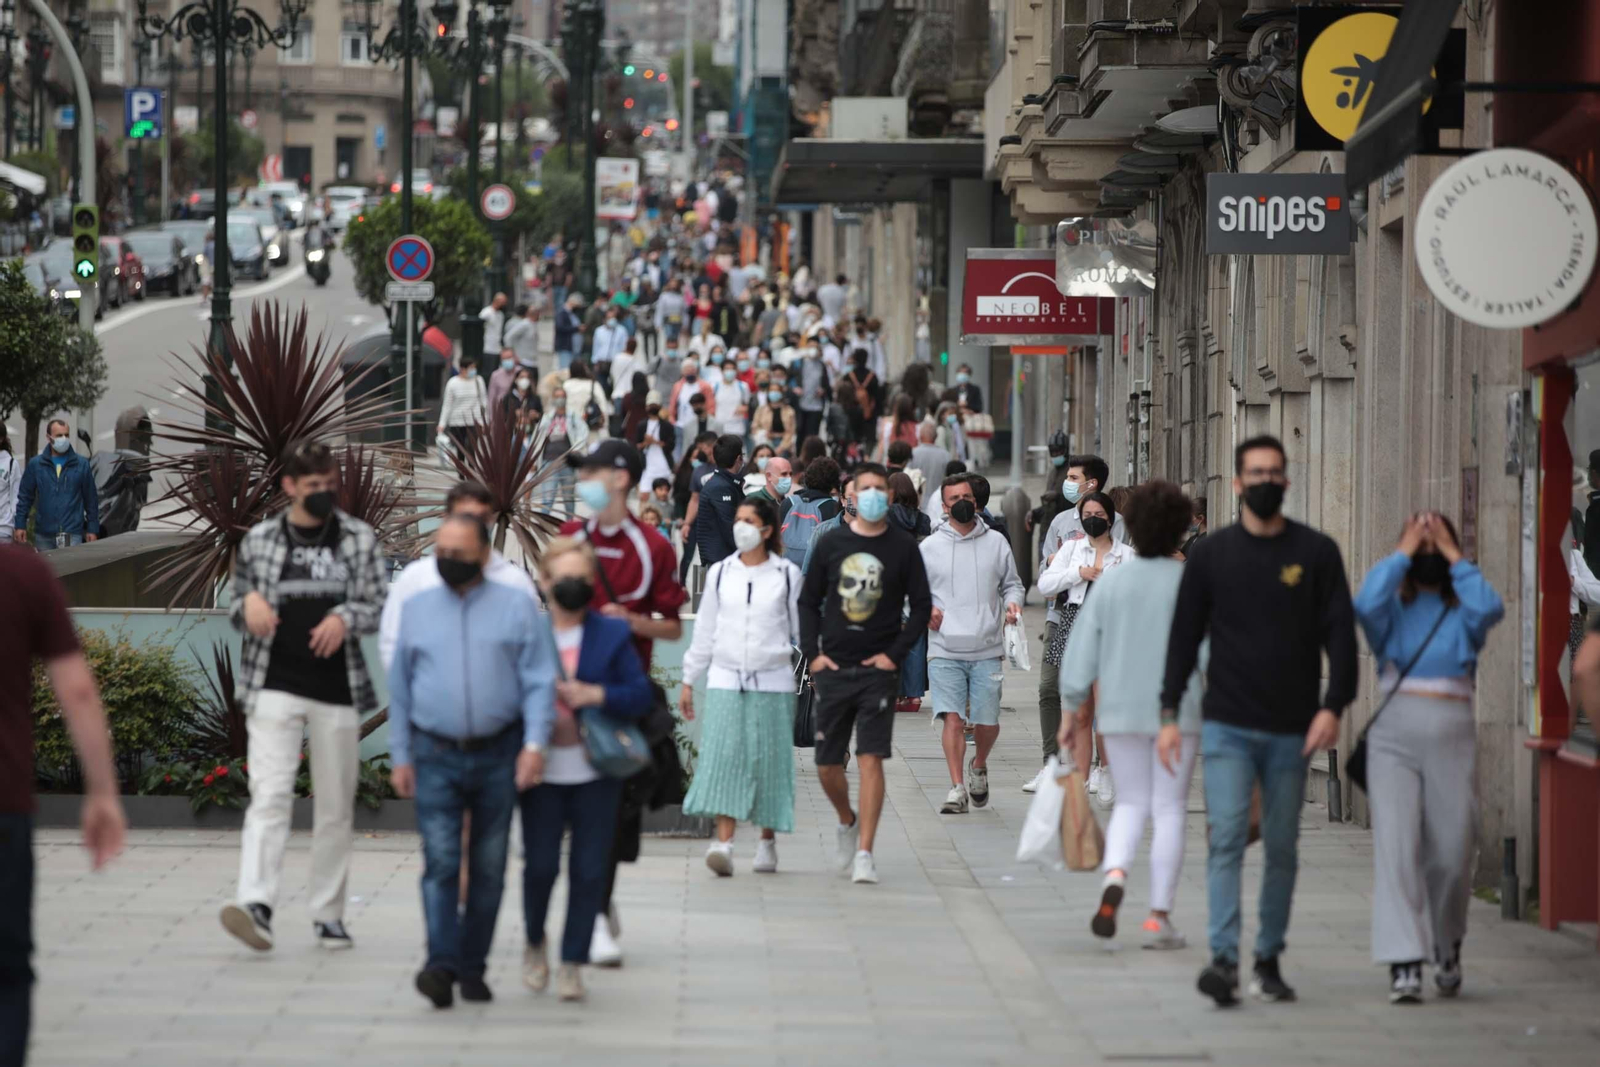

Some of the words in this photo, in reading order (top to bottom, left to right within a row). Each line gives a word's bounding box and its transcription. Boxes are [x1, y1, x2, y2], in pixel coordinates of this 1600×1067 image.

[131, 91, 156, 121] P
[1218, 196, 1326, 240] snipes
[1553, 231, 1585, 290] TIENDA
[993, 302, 1086, 315] NEOBEL
[1484, 295, 1545, 315] TALLER
